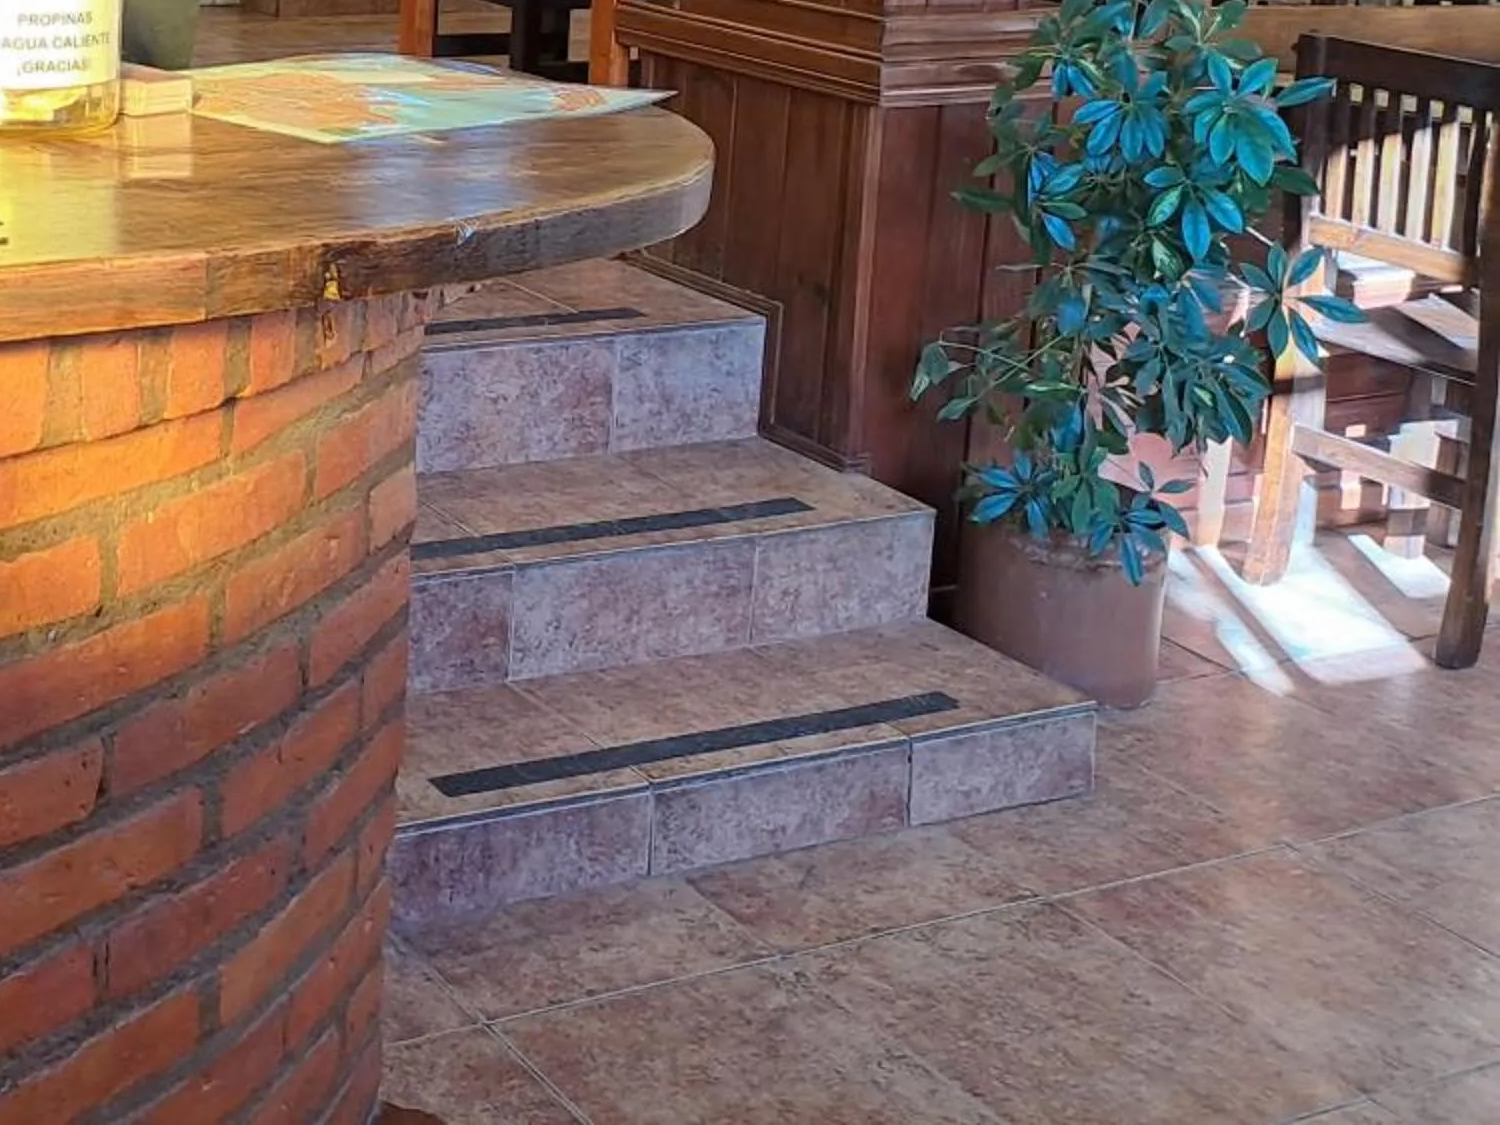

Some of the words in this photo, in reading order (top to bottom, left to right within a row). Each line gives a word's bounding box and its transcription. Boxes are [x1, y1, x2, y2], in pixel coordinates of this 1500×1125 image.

[17, 11, 92, 26] PROPINAS
[0, 36, 48, 51] AGUA
[51, 32, 111, 49] CALIENTE
